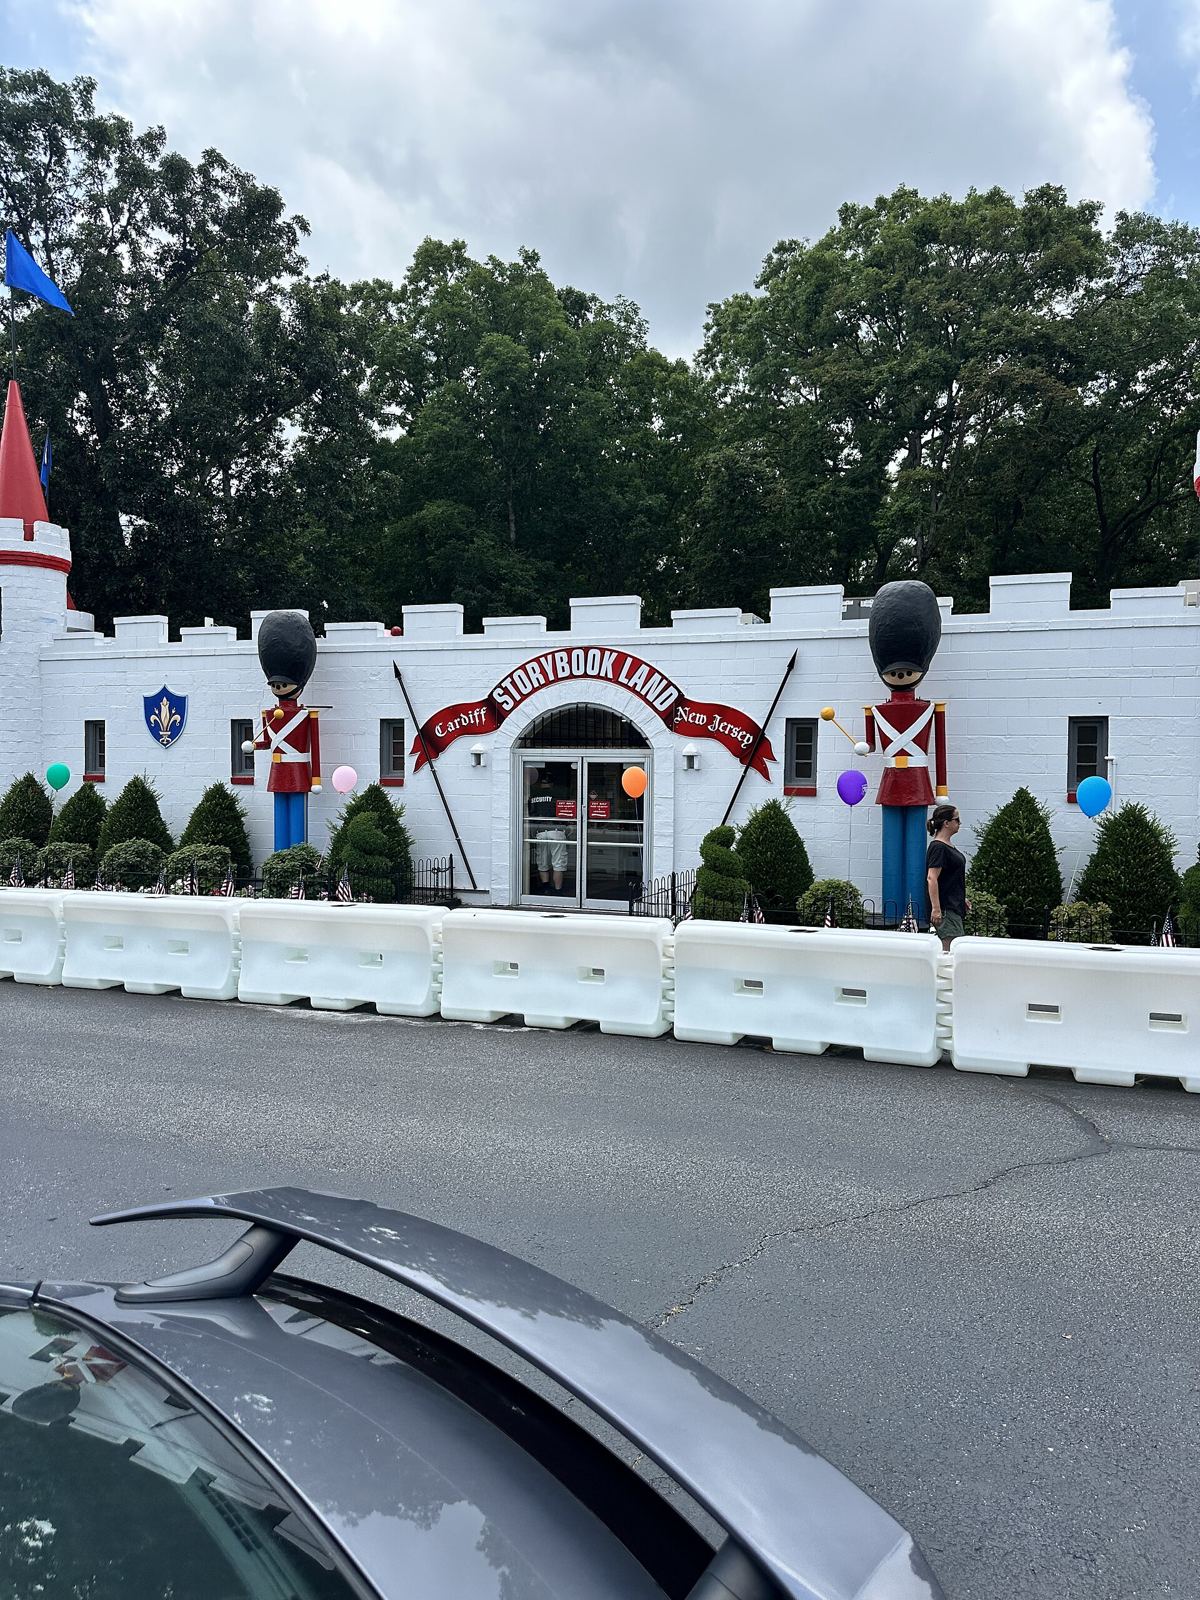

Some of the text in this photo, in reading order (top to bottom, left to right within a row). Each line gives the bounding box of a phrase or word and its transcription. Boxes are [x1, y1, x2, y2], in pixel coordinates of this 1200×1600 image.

[492, 648, 679, 713] STORYBOOK LAND
[435, 706, 488, 737] Cardiff
[674, 706, 753, 749] New Jersey
[531, 796, 553, 804] SECURITY
